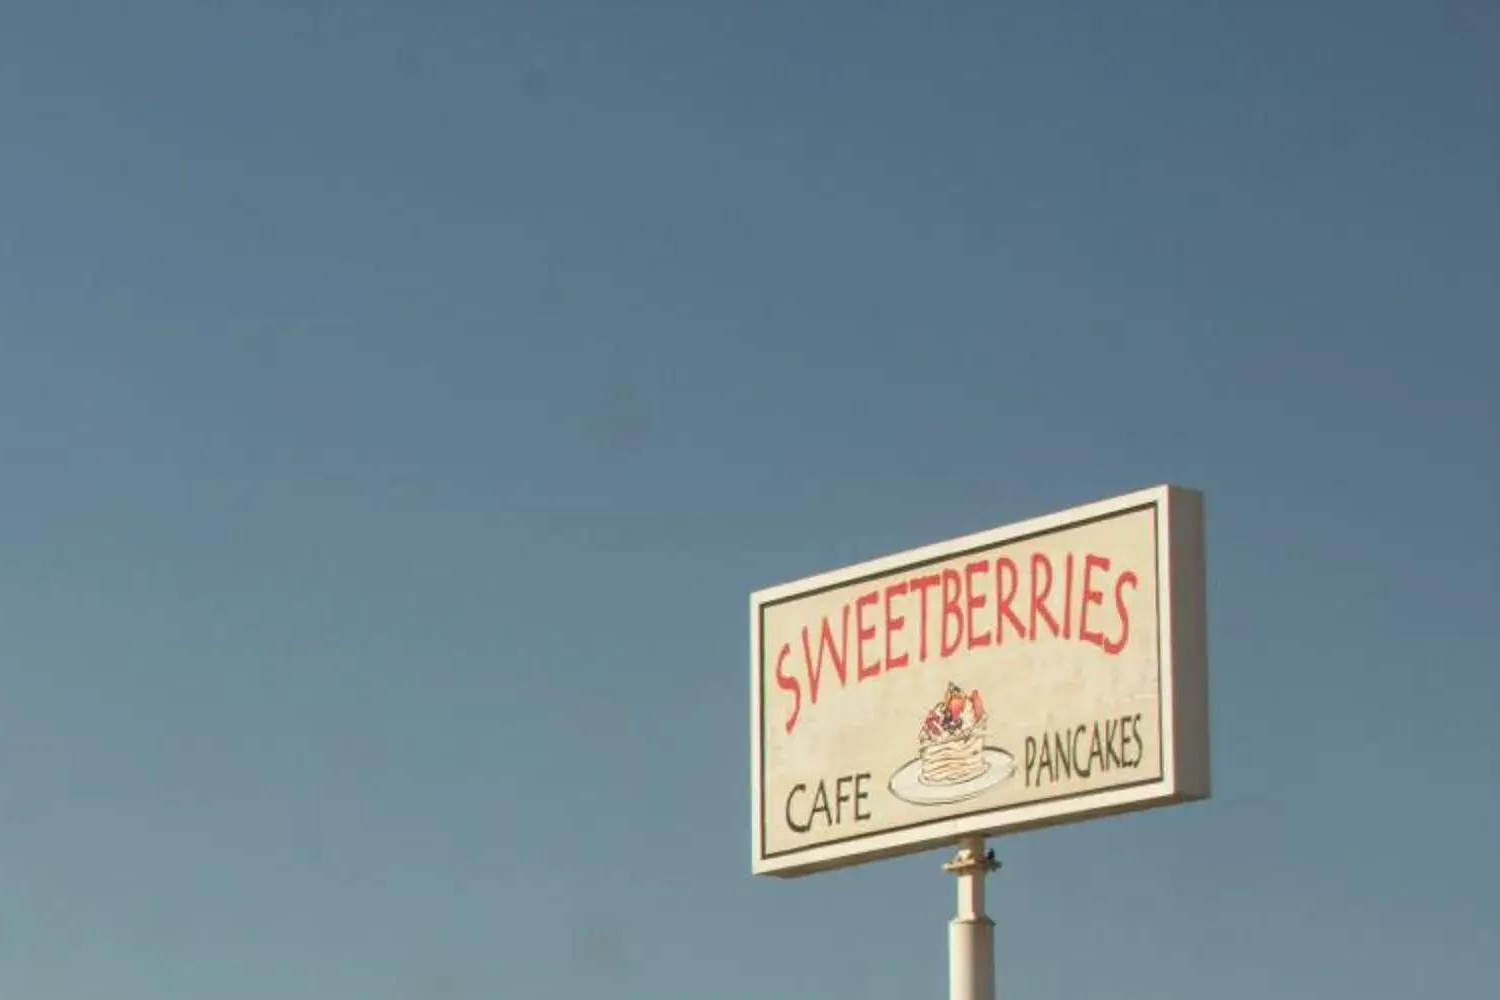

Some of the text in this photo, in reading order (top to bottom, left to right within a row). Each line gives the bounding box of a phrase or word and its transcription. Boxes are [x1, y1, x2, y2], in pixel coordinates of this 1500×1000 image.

[775, 552, 1139, 735] SWEETBERRIES
[785, 713, 1144, 833] CAFE PANCAKES
